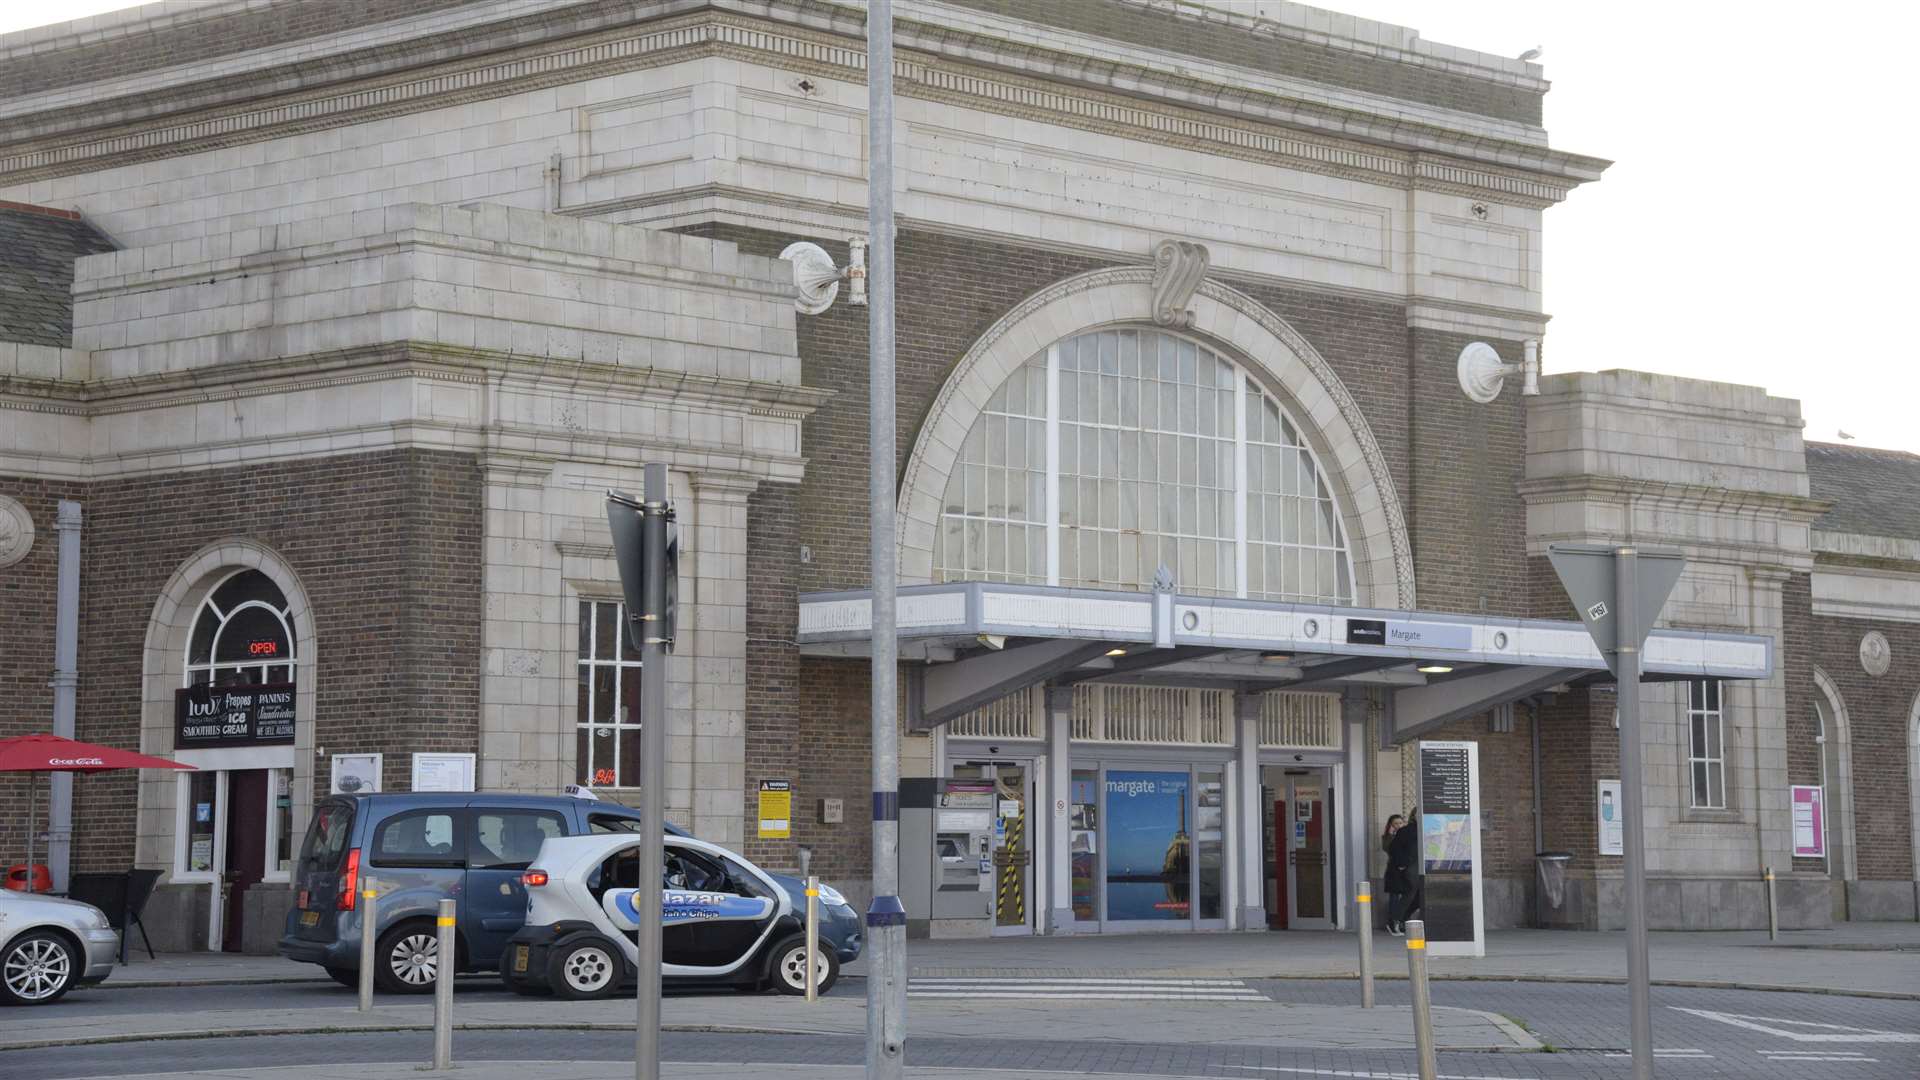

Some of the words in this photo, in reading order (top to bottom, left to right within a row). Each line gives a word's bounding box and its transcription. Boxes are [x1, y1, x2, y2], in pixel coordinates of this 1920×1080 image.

[1391, 628, 1421, 641] Margate
[250, 642, 276, 654] OPEN
[259, 692, 291, 704] PANINIS
[183, 725, 221, 737] SMOOTHIES
[222, 724, 248, 735] CREAM
[48, 758, 103, 766] Coca-Cola
[1105, 780, 1155, 797] margate
[664, 909, 679, 917] ish
[689, 909, 720, 919] Chips
